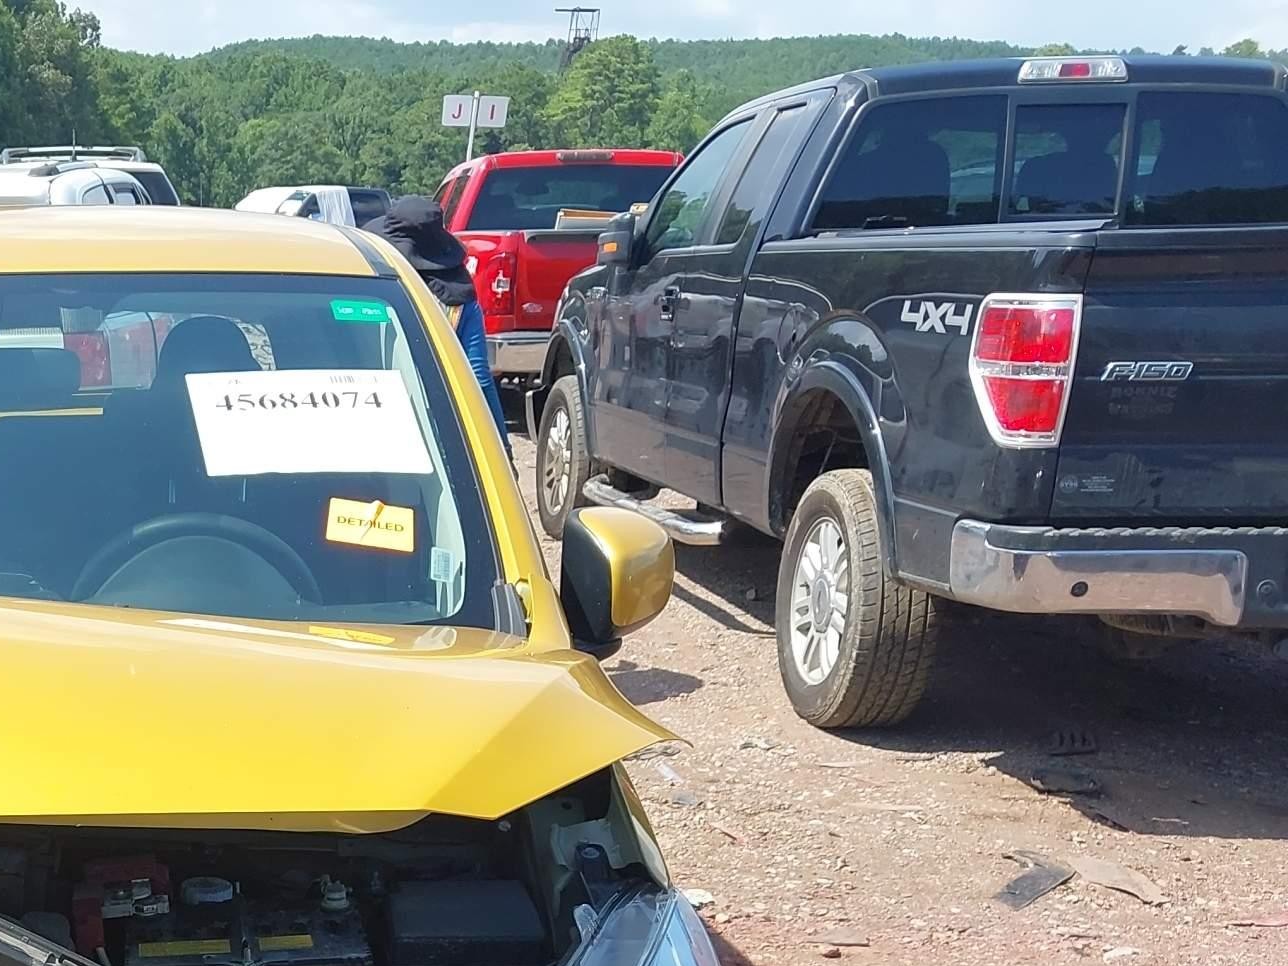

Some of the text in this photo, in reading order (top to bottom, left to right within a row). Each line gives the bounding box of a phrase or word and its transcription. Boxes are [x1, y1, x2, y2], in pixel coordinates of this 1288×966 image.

[452, 103, 462, 119] J
[900, 300, 974, 335] 4X4
[1100, 361, 1194, 381] F-150
[215, 391, 382, 411] 45684074
[337, 516, 404, 532] DETAILED
